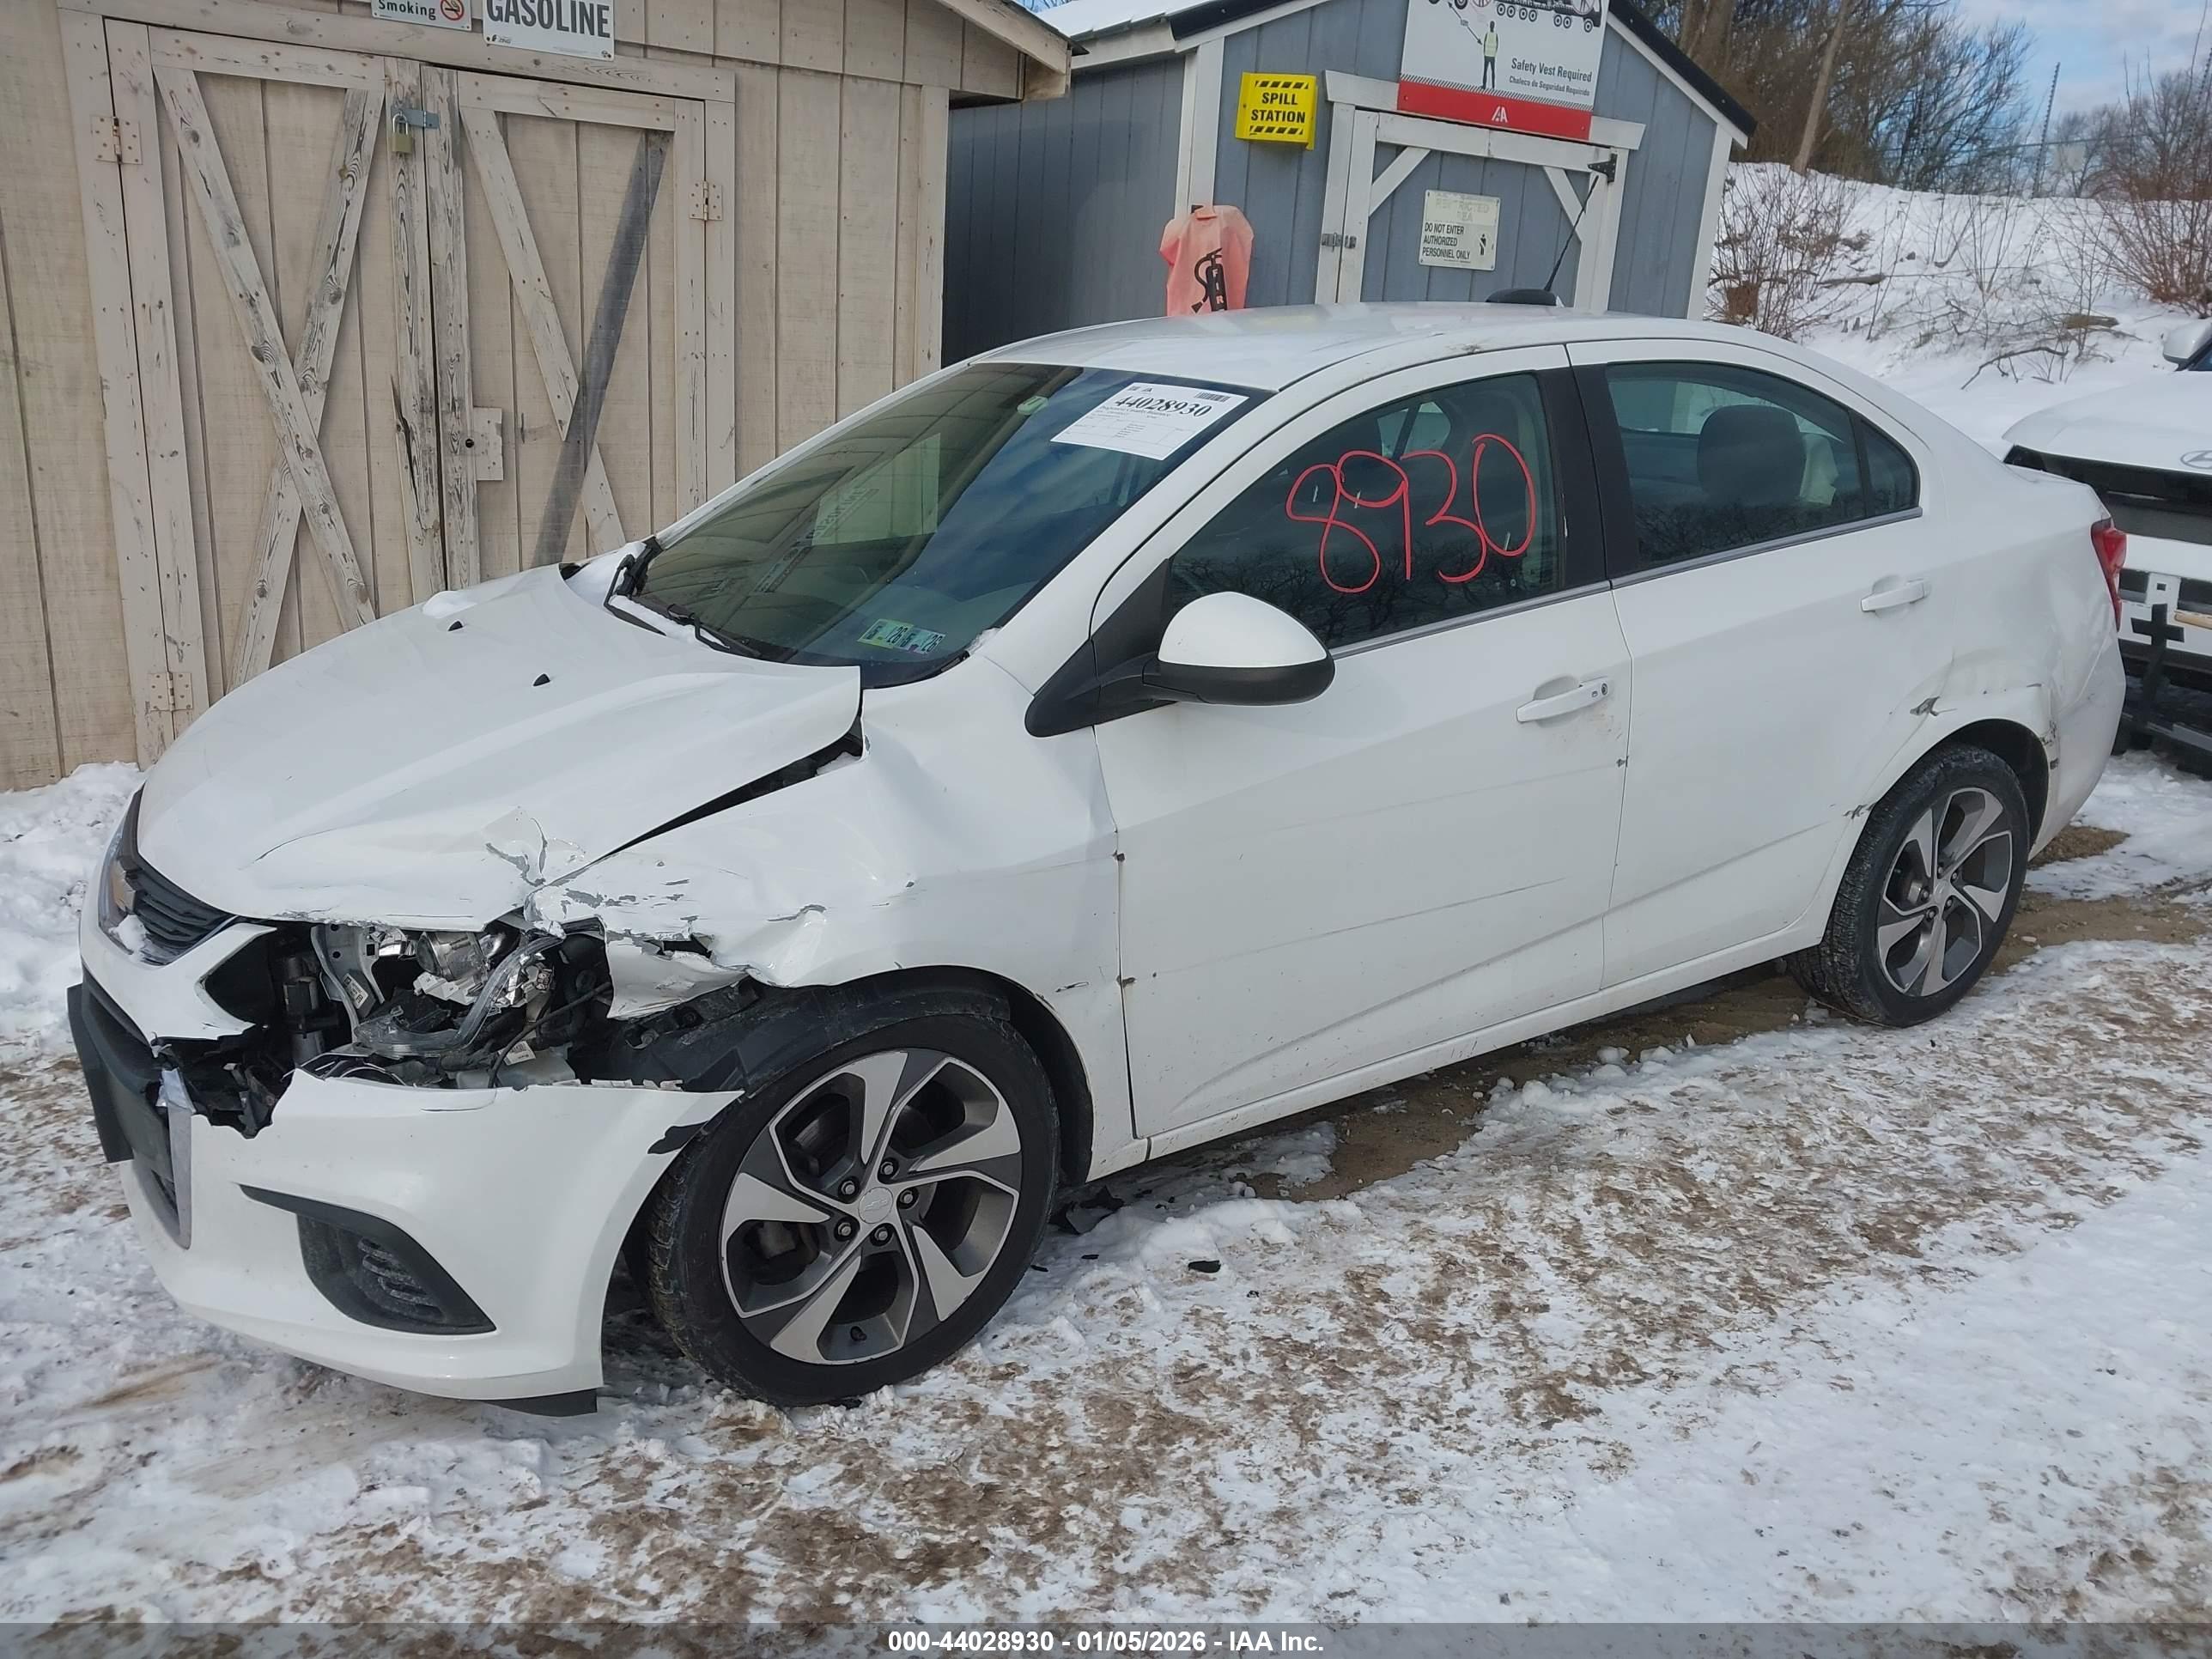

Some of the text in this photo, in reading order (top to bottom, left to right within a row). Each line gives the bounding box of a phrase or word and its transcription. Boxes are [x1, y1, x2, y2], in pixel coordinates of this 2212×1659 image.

[379, 0, 436, 21] Smoking
[486, 0, 611, 39] GASOLINE
[1511, 58, 1593, 82] Safety Vest Required
[1509, 76, 1530, 87] Chaleco
[1531, 79, 1539, 88] de
[1539, 81, 1565, 92] Seguridad
[1261, 92, 1298, 105] SPILL
[1251, 109, 1305, 124] STATION
[1425, 222, 1464, 234] DO NOT ENTER
[1423, 235, 1458, 246] AUTHORIZED
[1422, 246, 1471, 259] PERSONNEL ONLY
[1115, 396, 1212, 417] 44028930
[1285, 433, 1536, 593] 8930
